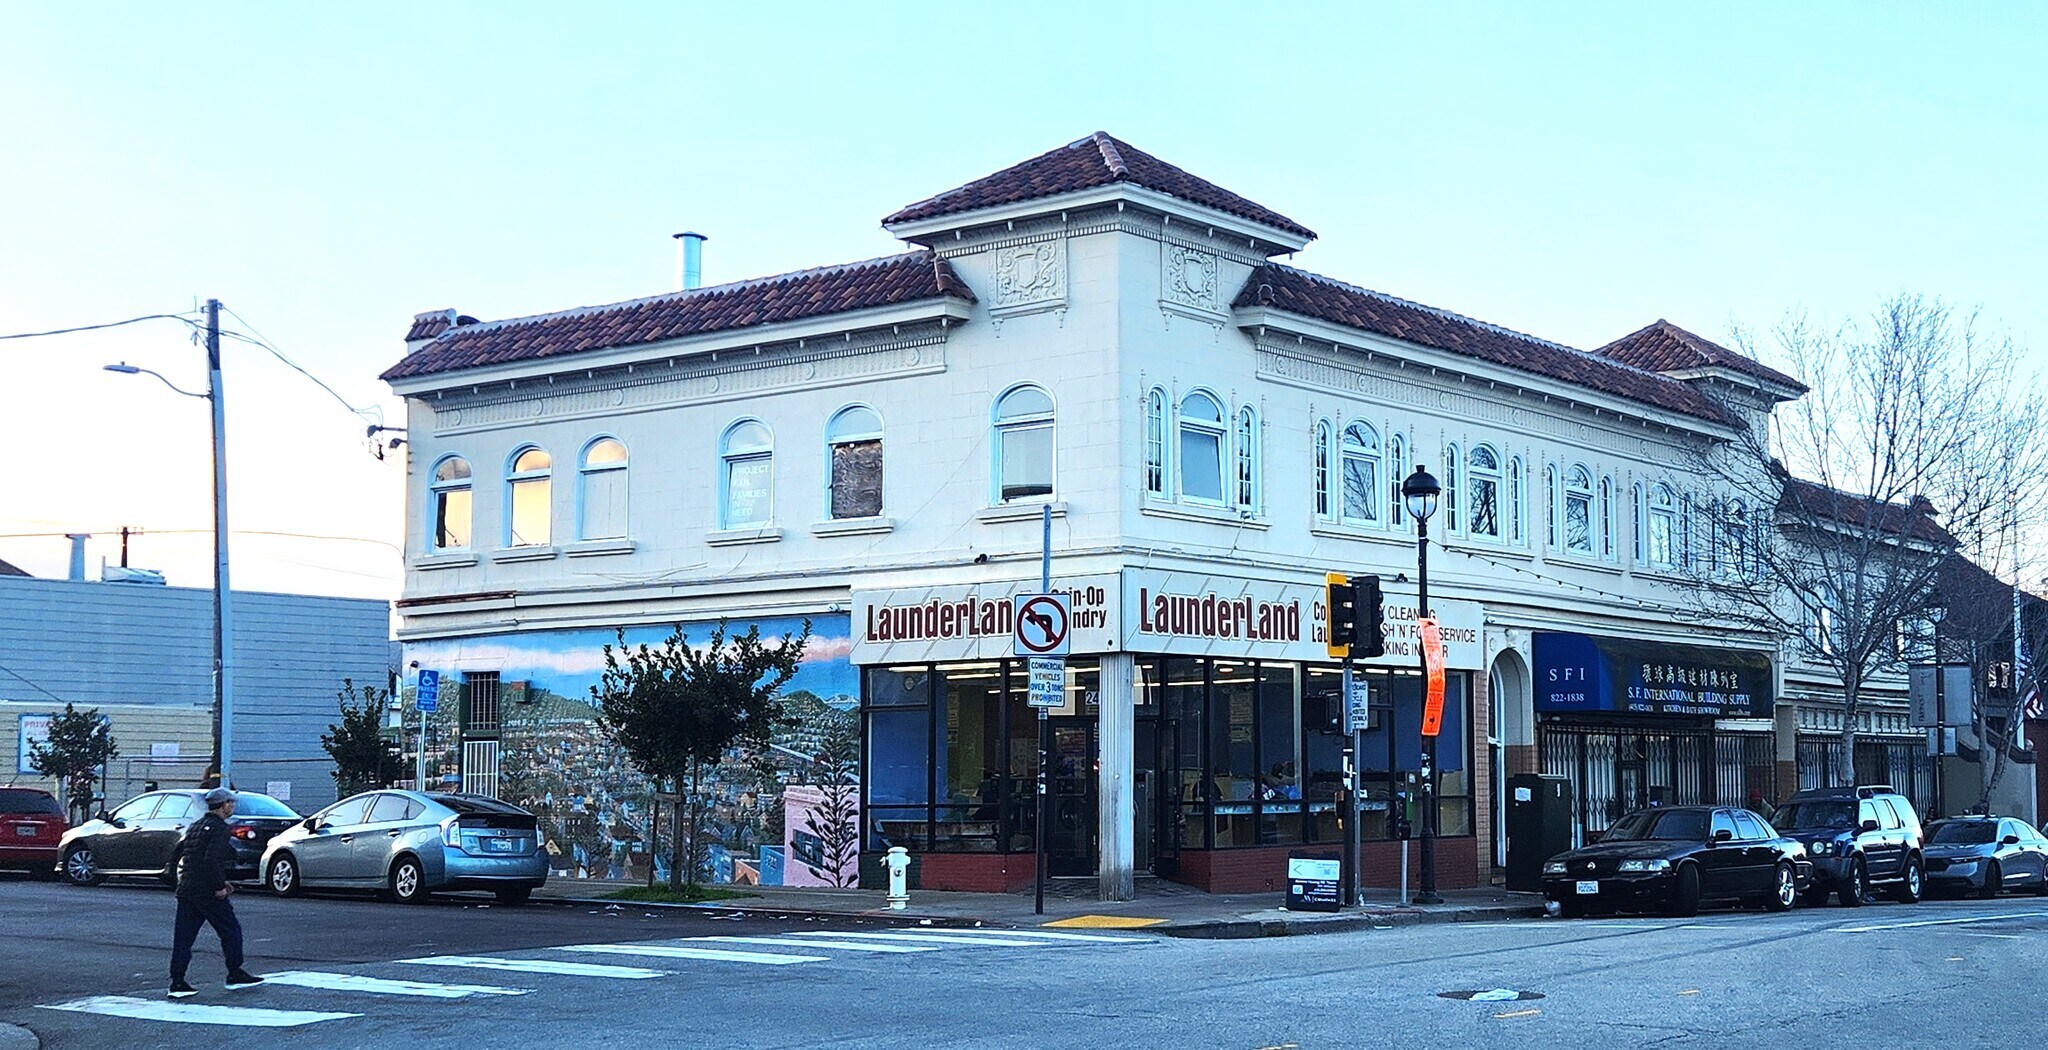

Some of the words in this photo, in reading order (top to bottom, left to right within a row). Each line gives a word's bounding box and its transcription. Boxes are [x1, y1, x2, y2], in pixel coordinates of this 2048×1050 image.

[866, 597, 1013, 642] LaunderLan
[1072, 608, 1107, 629] ndry
[1139, 587, 1301, 642] LaunderLand
[1388, 605, 1437, 621] CLEANG
[1382, 622, 1395, 637] SH
[1438, 627, 1476, 643] SERVICE
[1384, 641, 1409, 656] KING
[1031, 661, 1064, 671] COMMERCIAL
[1034, 672, 1061, 682] VEHICLES
[1030, 682, 1045, 691] OVER
[1045, 681, 1051, 693] 3
[1051, 683, 1064, 692] TONS
[1031, 692, 1063, 703] PROHIBITED
[1550, 693, 1585, 702] 822-1838
[1643, 687, 1696, 703] INTERNATIONAL
[1697, 691, 1728, 705] BUILDING
[1728, 693, 1751, 706] SUPPLY
